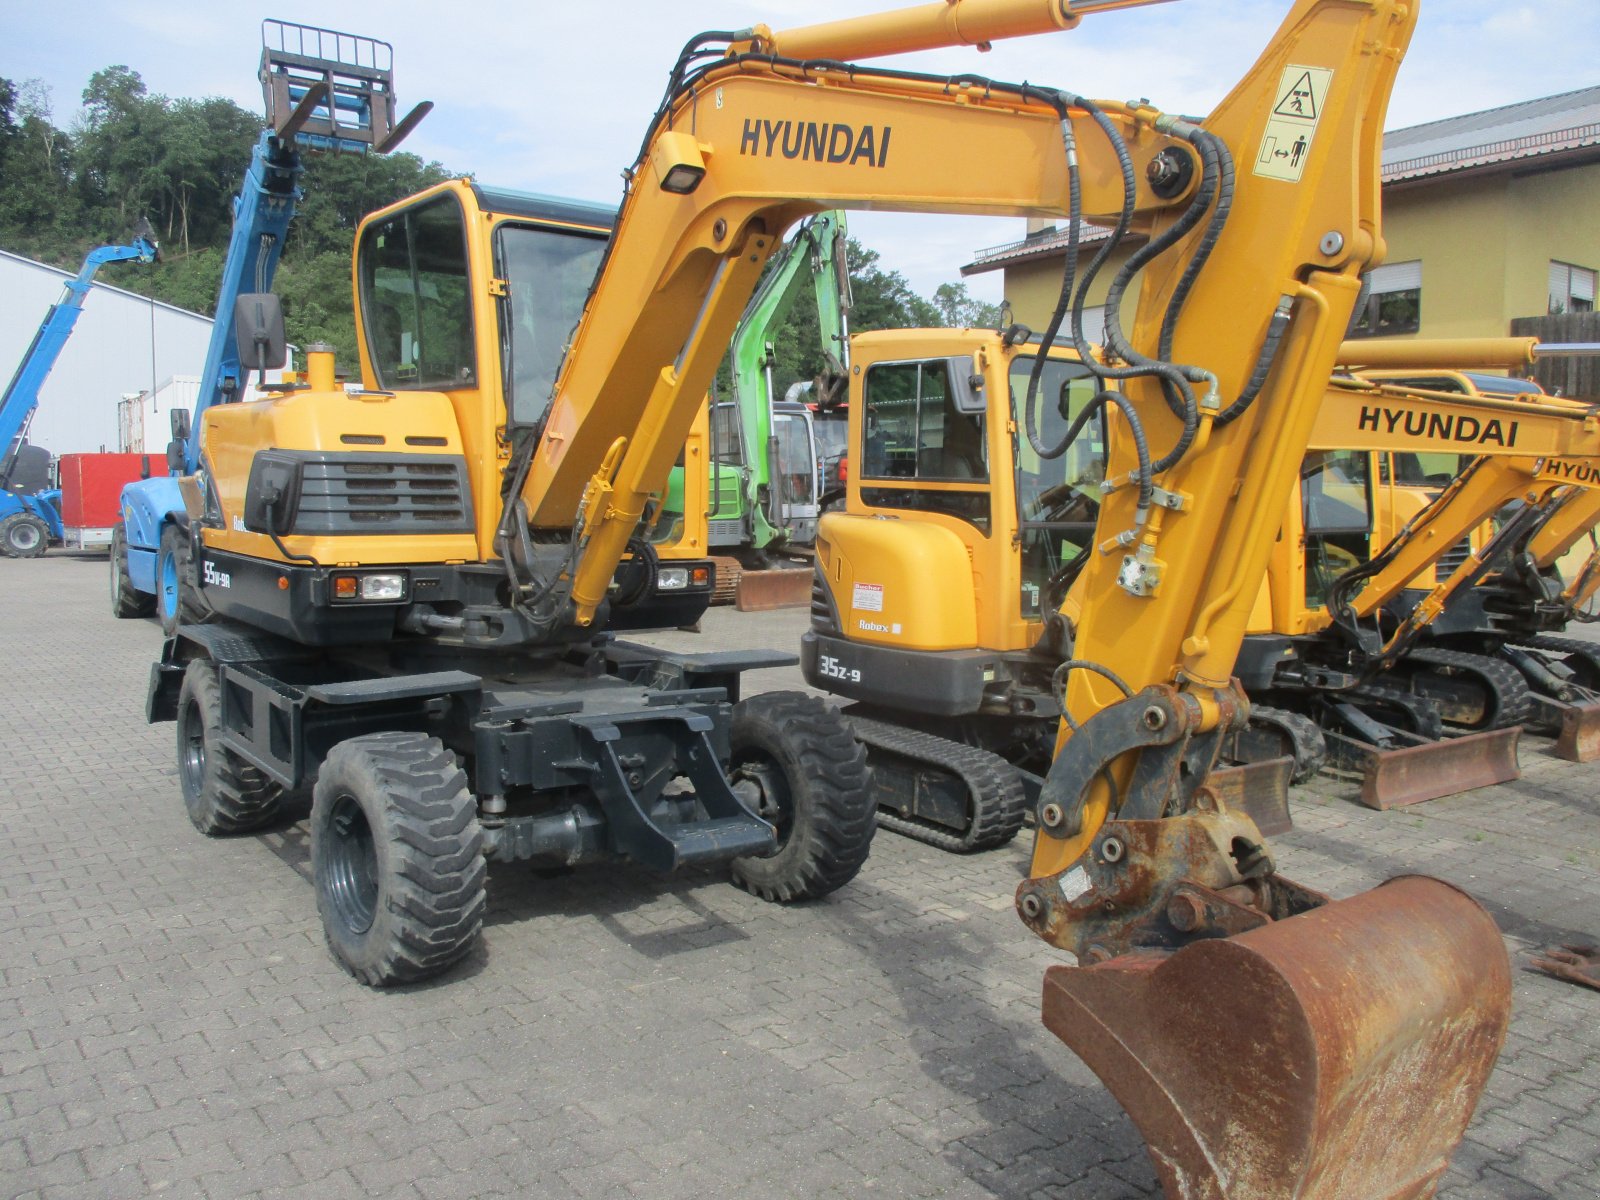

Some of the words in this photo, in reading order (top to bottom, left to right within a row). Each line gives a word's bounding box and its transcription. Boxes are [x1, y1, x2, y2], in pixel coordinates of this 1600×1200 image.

[740, 118, 892, 168] HYUNDAI
[1358, 405, 1519, 448] HYUNDAI
[855, 583, 881, 591] Bucher
[859, 619, 889, 633] Robex
